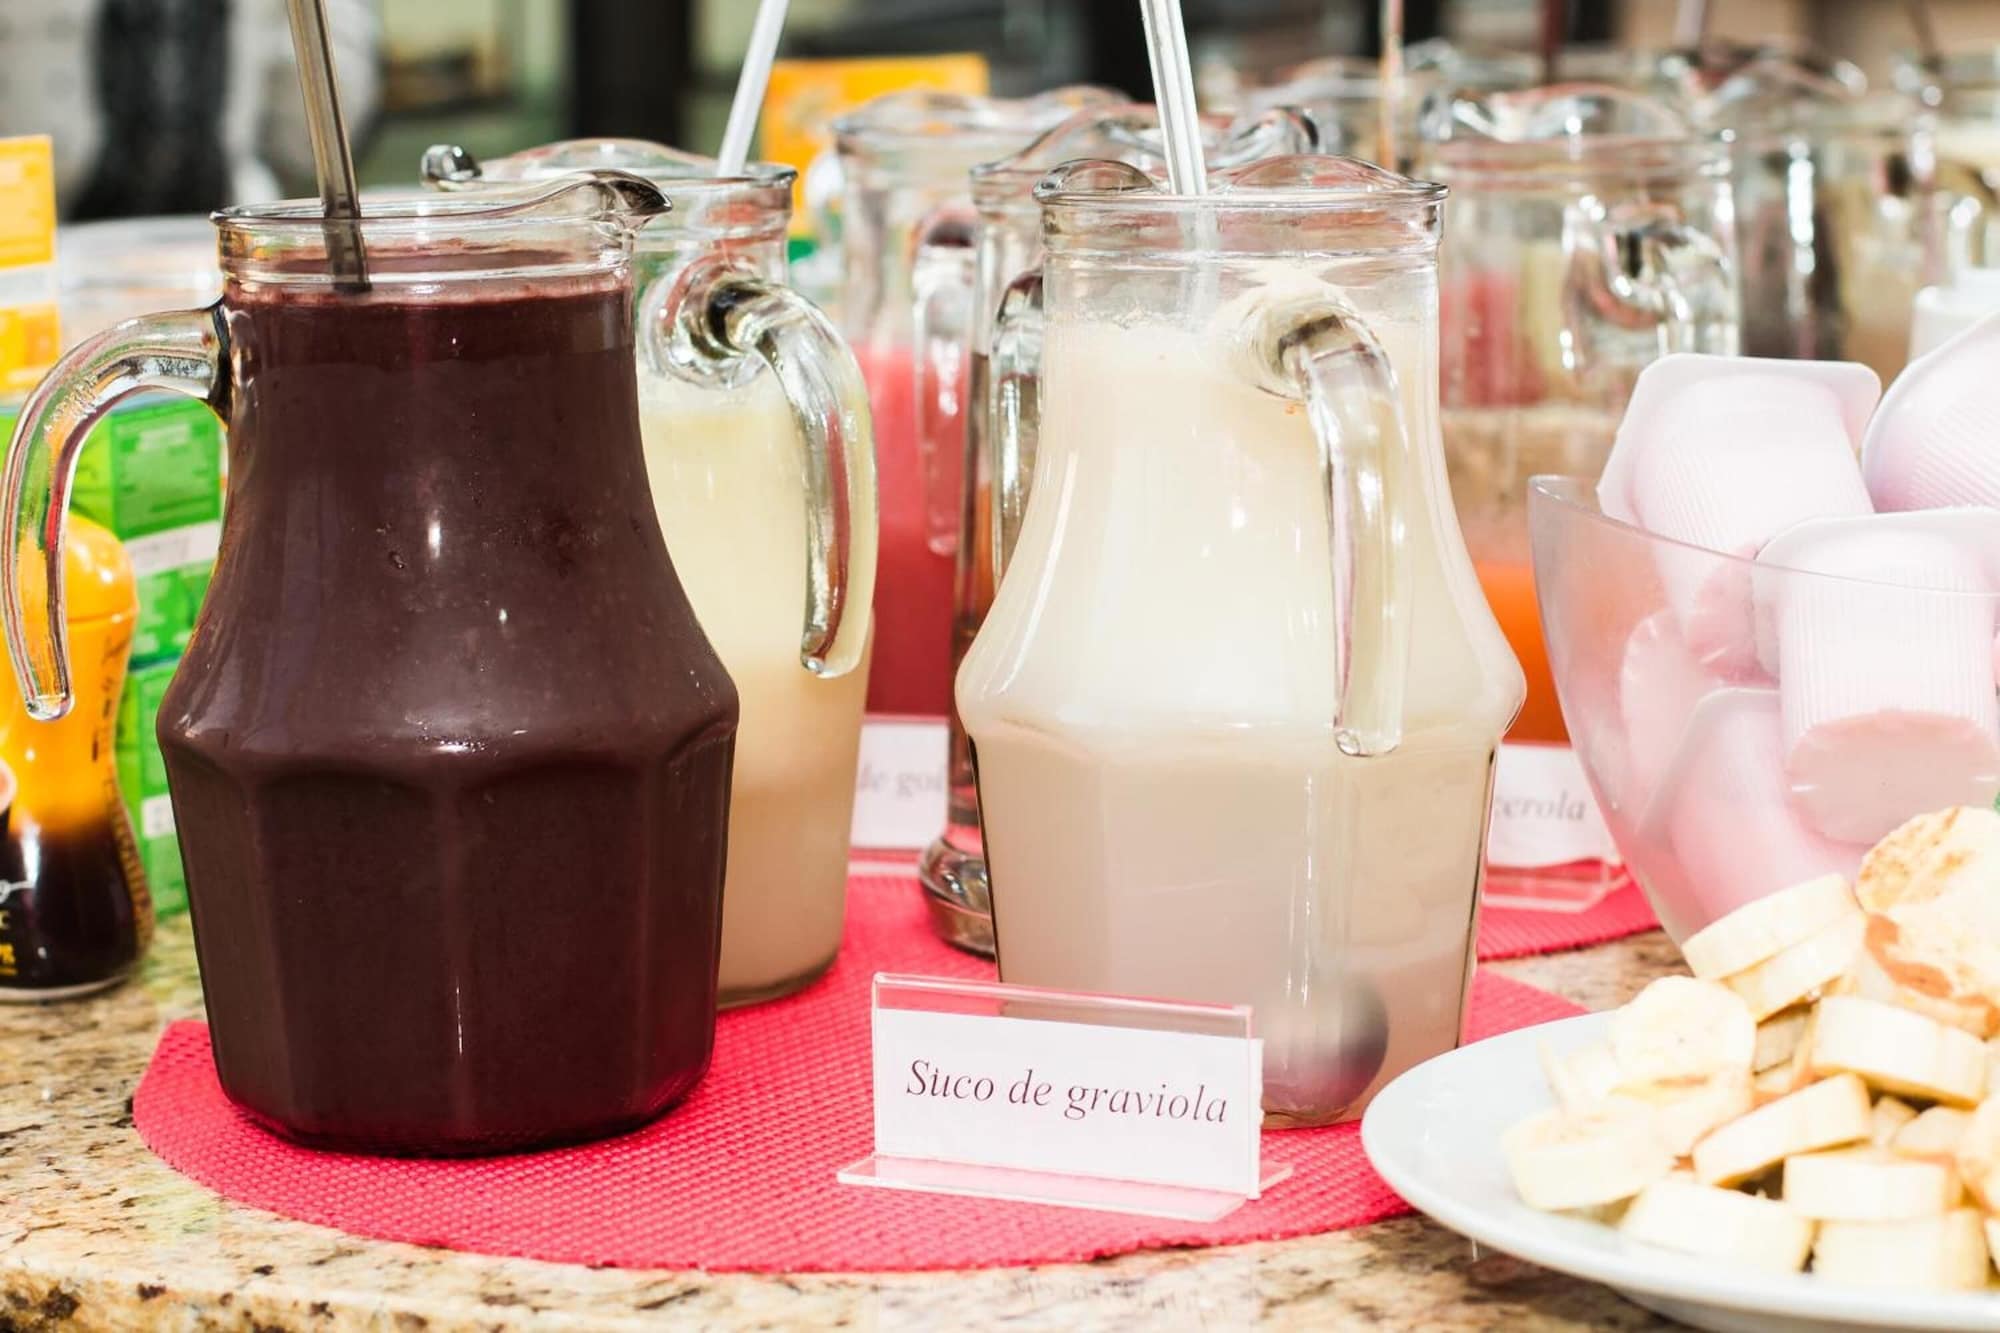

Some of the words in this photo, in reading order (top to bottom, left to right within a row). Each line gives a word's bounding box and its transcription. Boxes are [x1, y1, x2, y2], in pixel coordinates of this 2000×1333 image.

[906, 1058, 994, 1101] Suco
[1008, 1068, 1052, 1106] de
[1064, 1083, 1227, 1123] graviola
